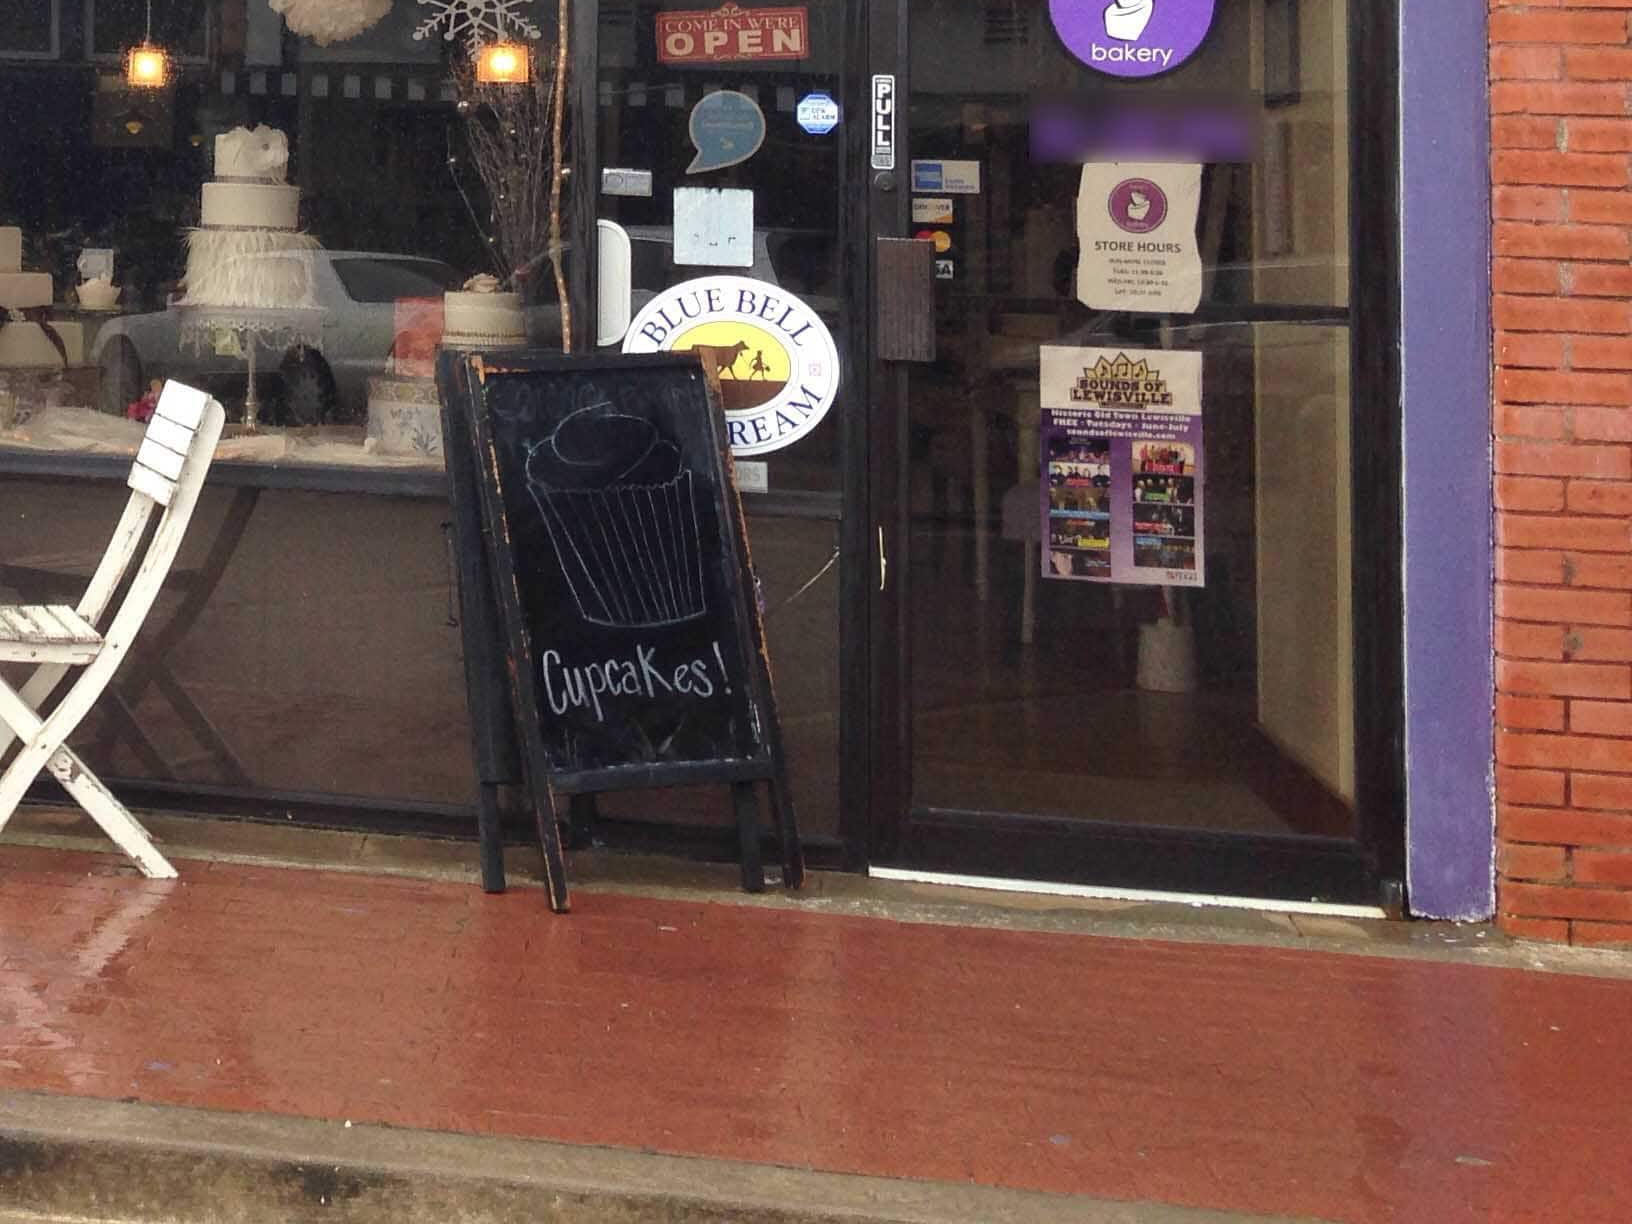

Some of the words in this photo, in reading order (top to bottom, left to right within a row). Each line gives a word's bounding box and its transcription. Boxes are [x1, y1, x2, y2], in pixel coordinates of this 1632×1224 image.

[665, 17, 719, 33] COME
[723, 16, 742, 31] IN
[665, 28, 802, 57] OPEN
[1091, 43, 1173, 66] bakery
[876, 83, 891, 146] PULL
[1094, 240, 1135, 252] STORE
[1137, 241, 1182, 254] HOURS
[640, 287, 726, 346] BLUE
[735, 288, 815, 347] BELL
[1078, 379, 1140, 392] SOUNDS
[1143, 380, 1164, 392] OF
[1072, 389, 1171, 405] LEWISVILLE
[727, 383, 824, 446] REAM
[1051, 408, 1093, 419] Historic
[1094, 409, 1113, 419] Old
[1114, 410, 1139, 420] Town
[1141, 411, 1192, 423] Lewisville
[1053, 418, 1080, 427] FREE
[1087, 419, 1132, 429] Tuesdays
